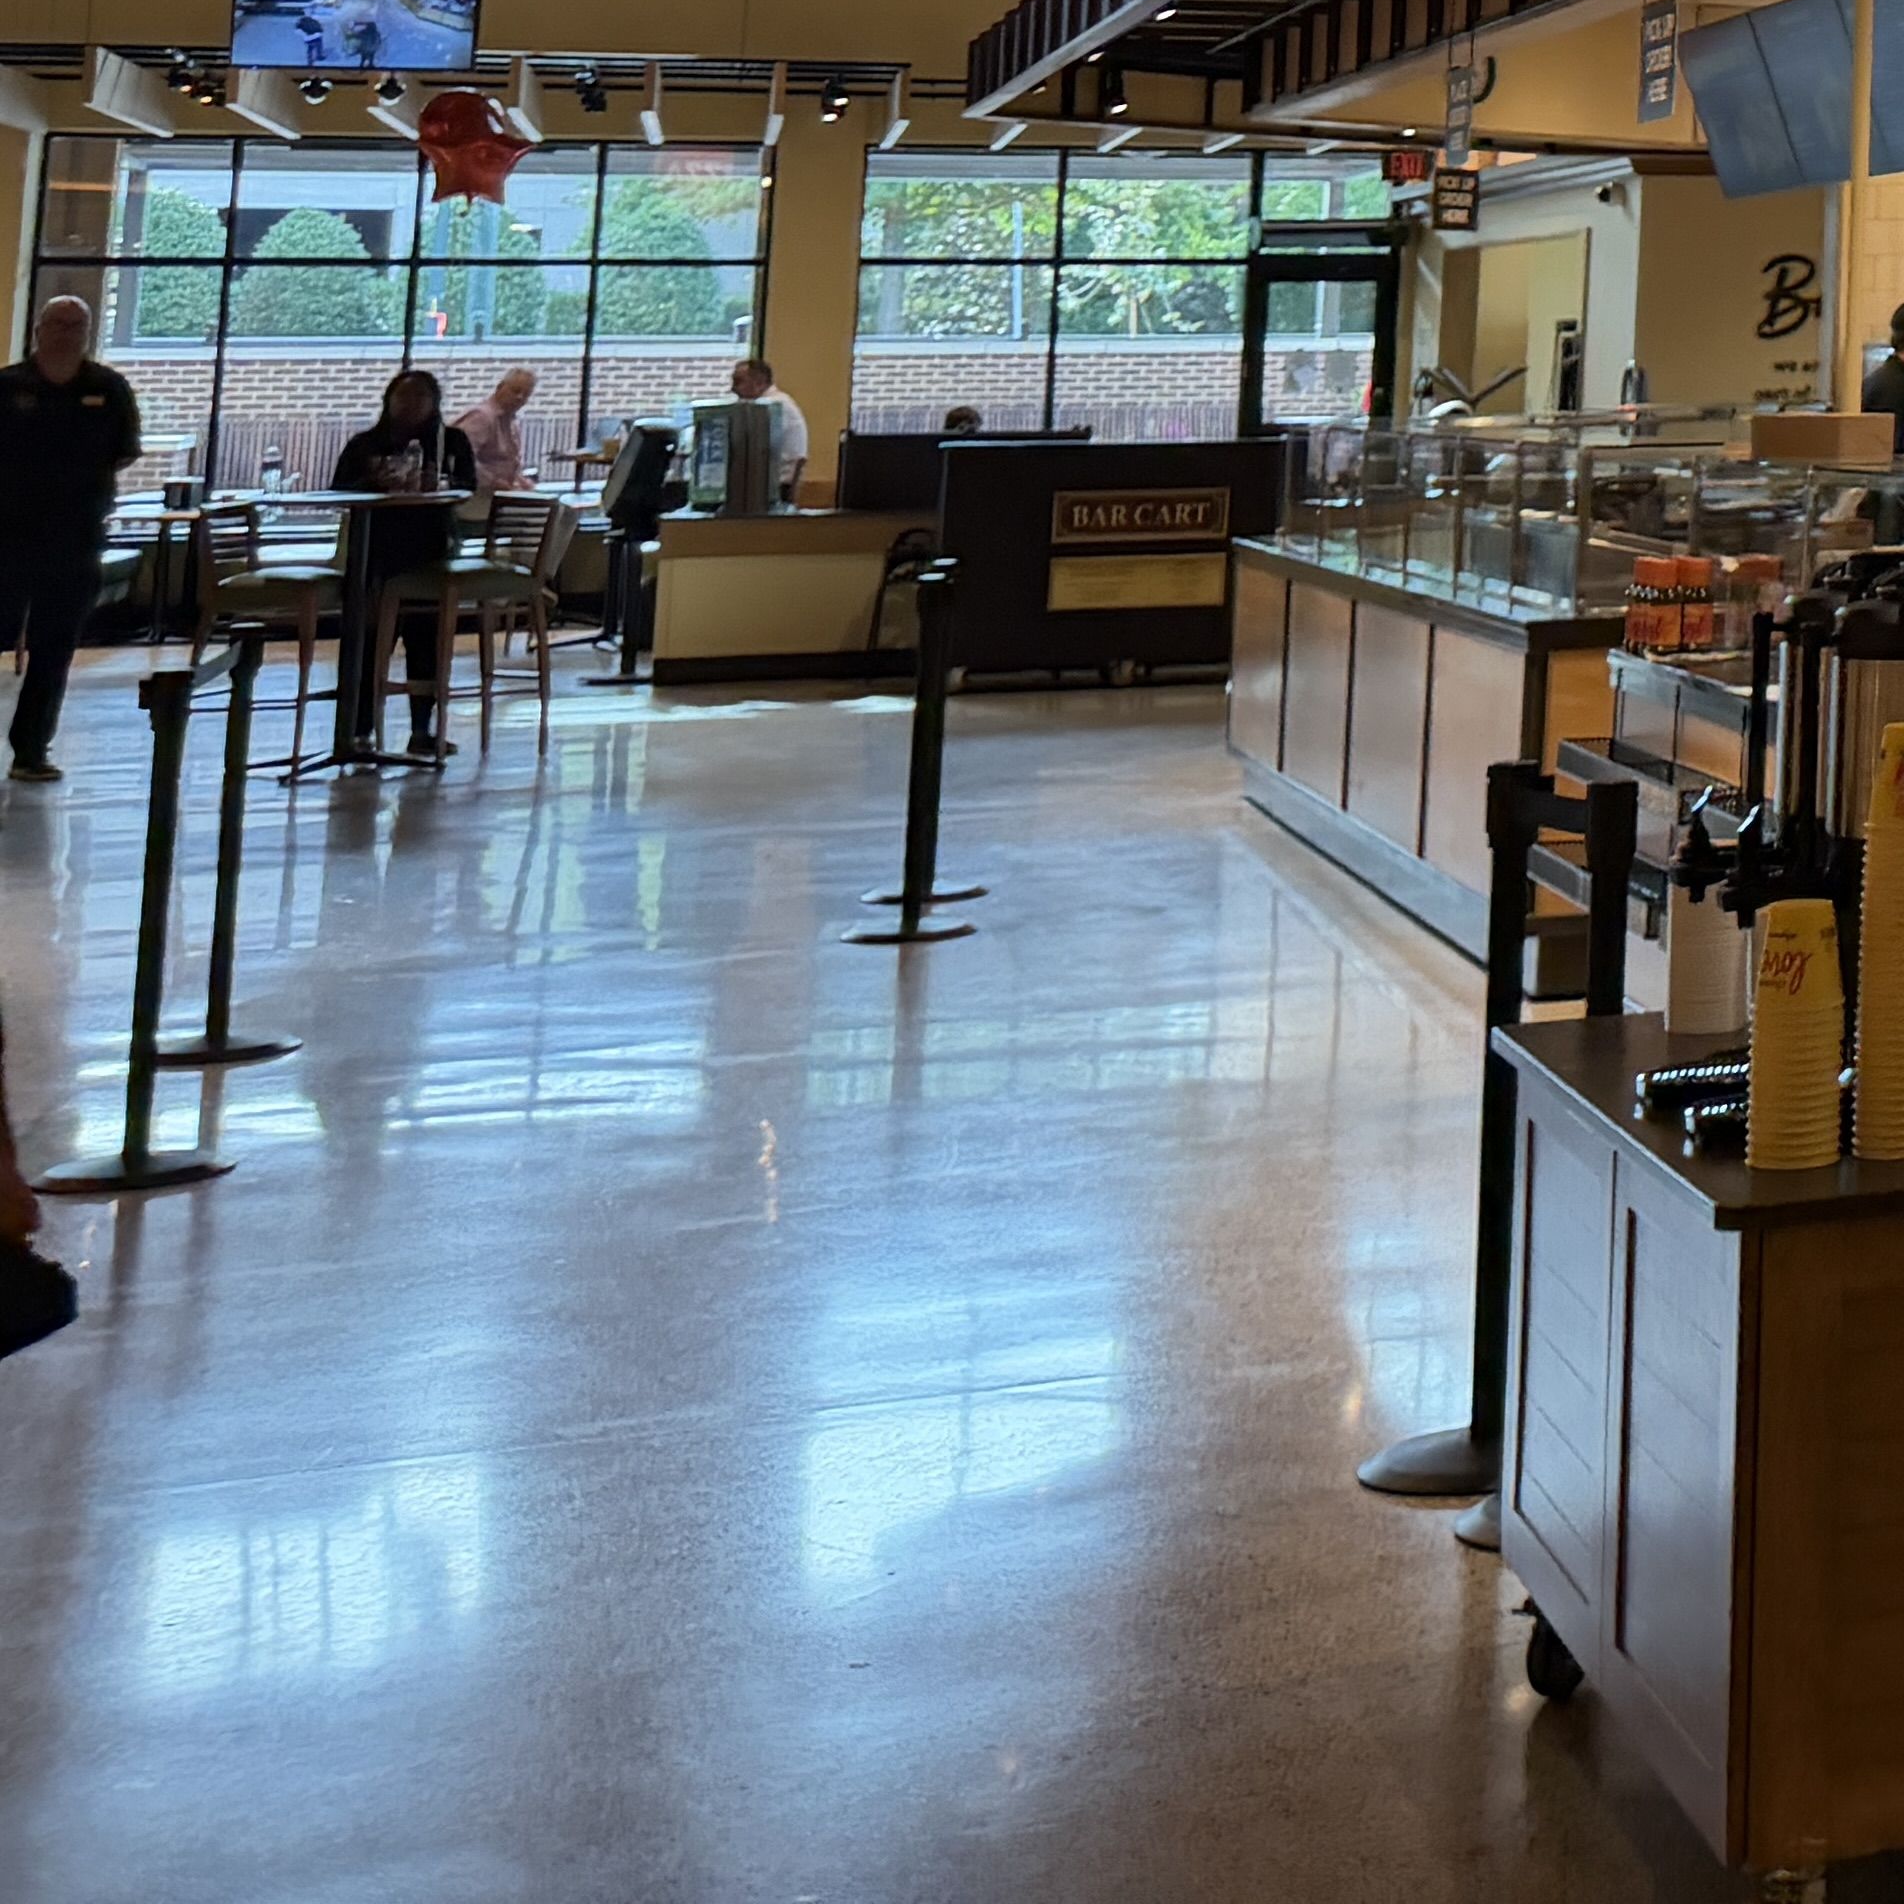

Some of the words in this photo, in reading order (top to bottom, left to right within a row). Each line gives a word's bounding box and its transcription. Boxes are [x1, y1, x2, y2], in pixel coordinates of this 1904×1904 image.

[1390, 152, 1424, 180] EXIT
[1072, 504, 1126, 528] BAR
[1133, 502, 1211, 527] CART
